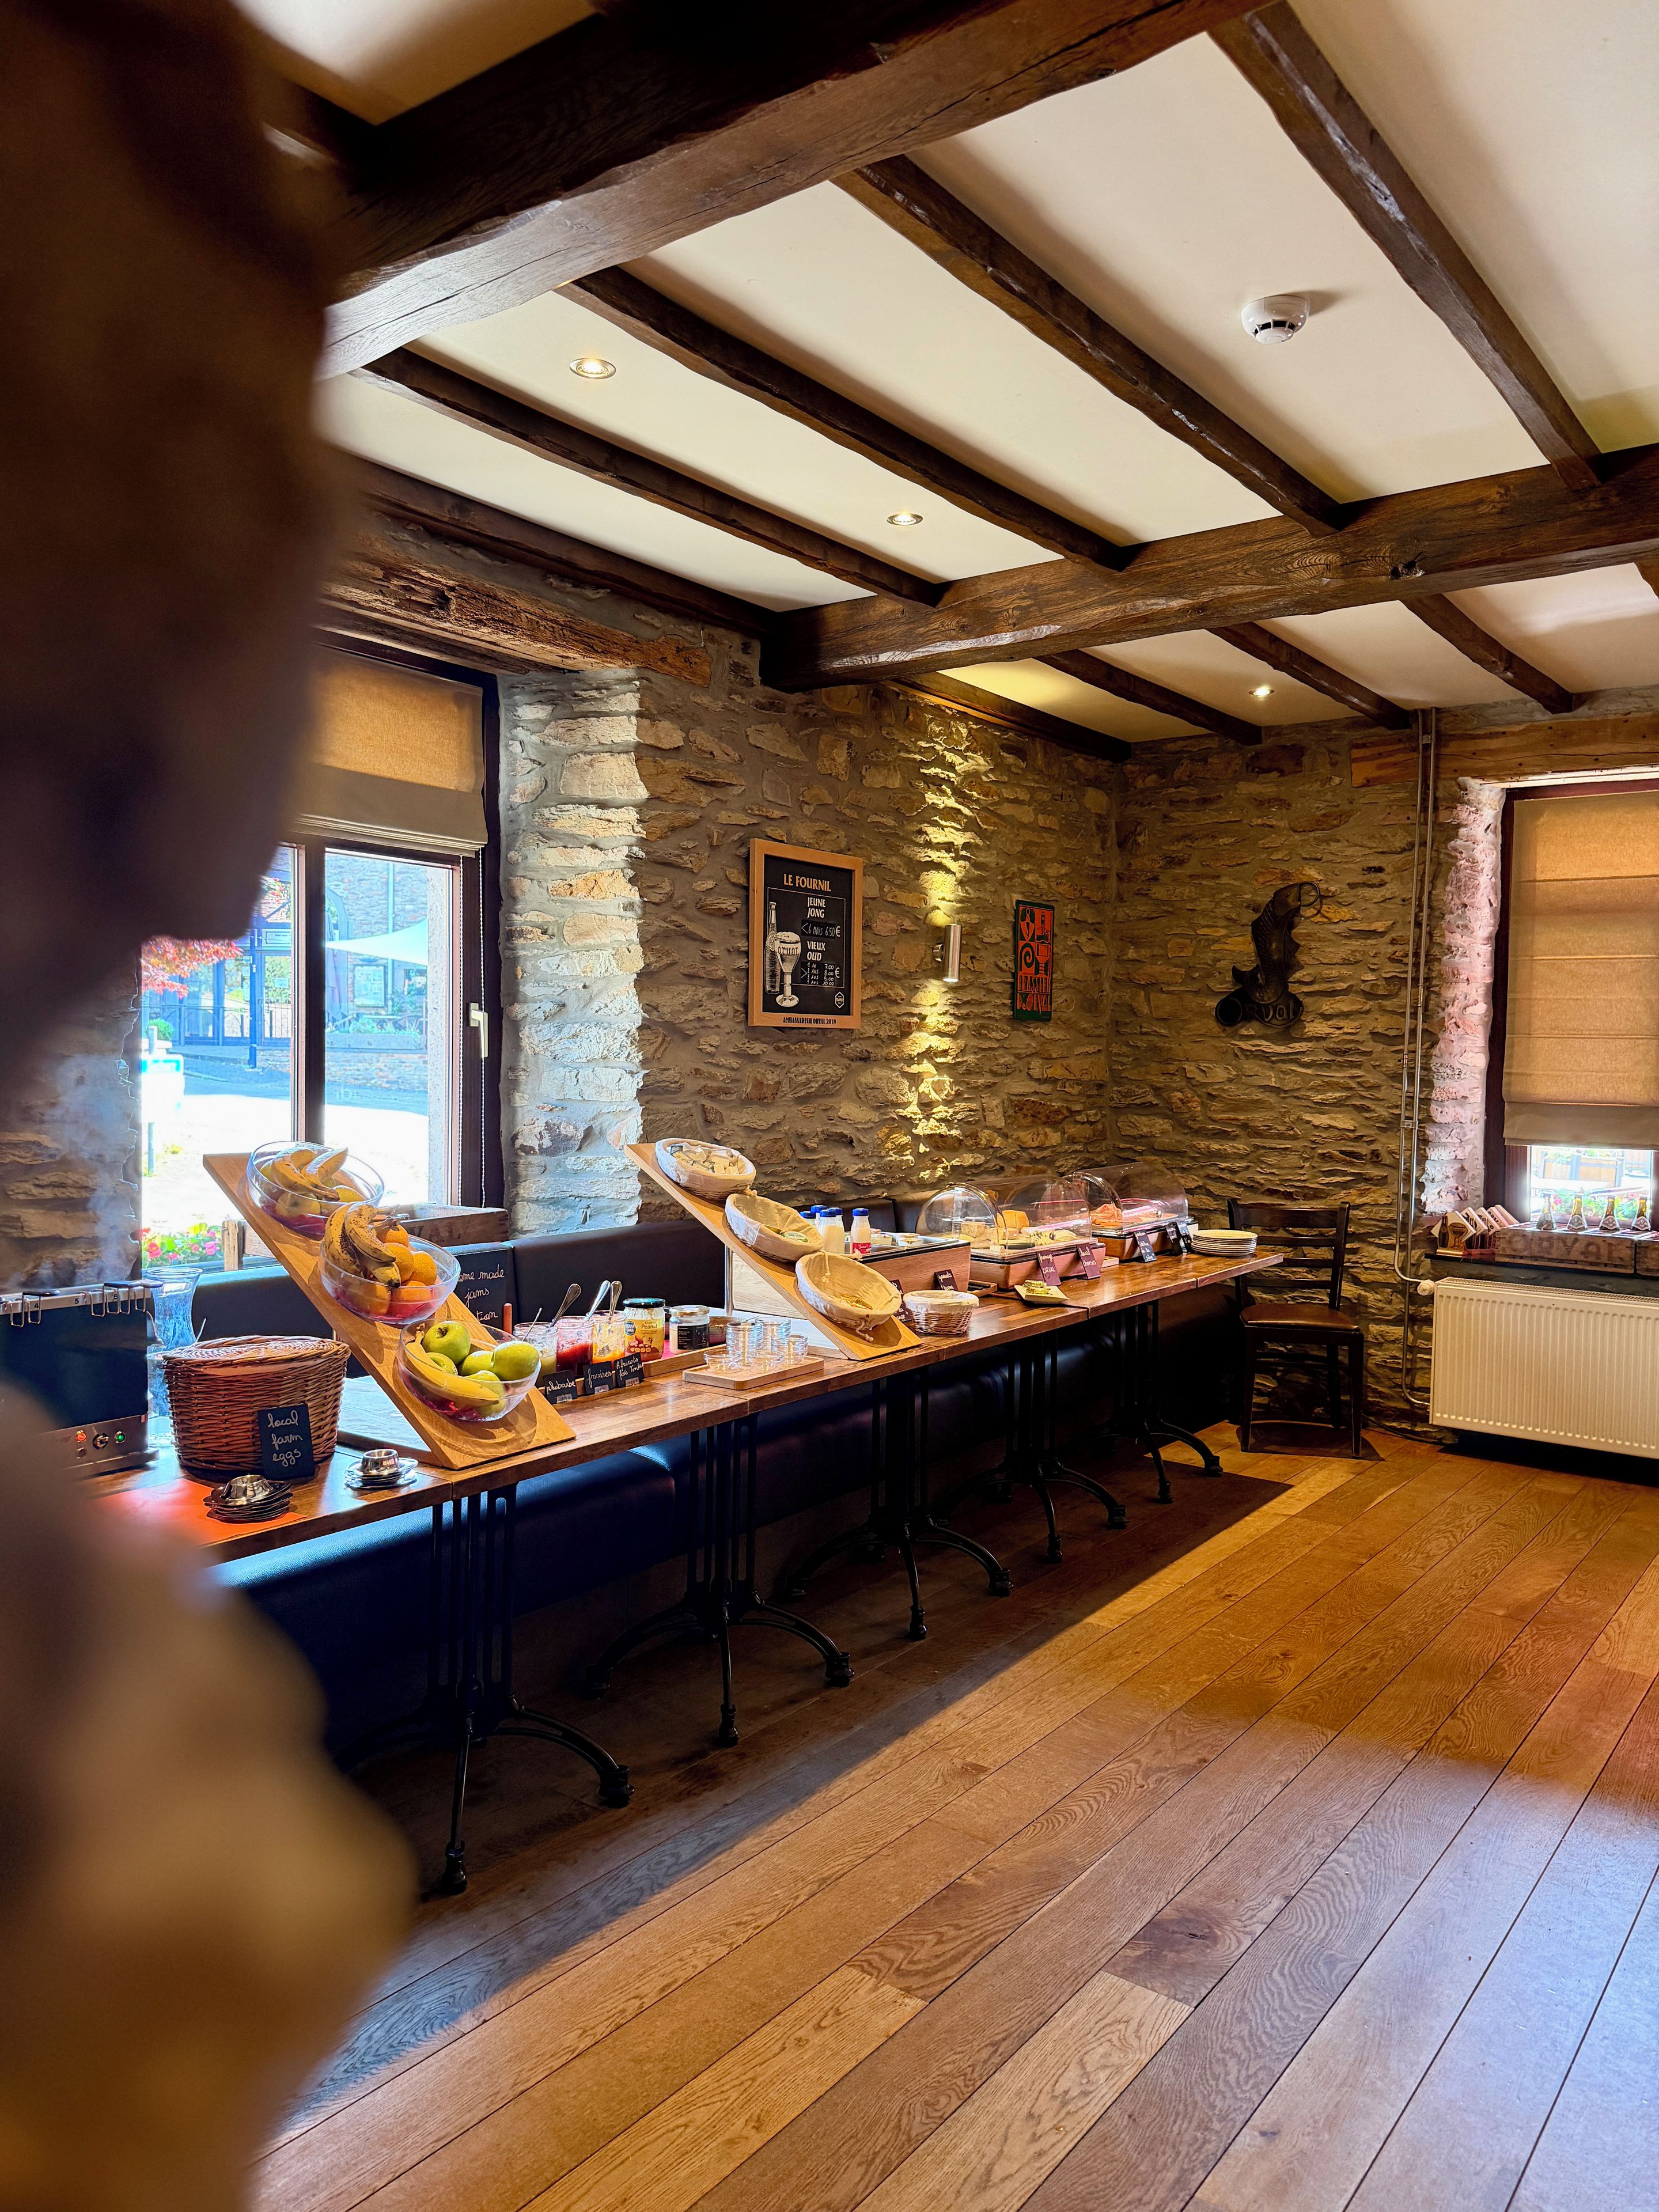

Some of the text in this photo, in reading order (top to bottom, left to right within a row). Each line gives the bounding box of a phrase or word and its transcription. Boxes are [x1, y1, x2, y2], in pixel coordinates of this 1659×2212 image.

[783, 873, 831, 892] LE FOURNIL
[807, 897, 826, 907] JEUNE
[806, 907, 825, 919] JONG
[806, 940, 826, 951] VIEUX
[806, 951, 822, 961] OUD
[459, 1264, 505, 1282] ome made
[464, 1287, 490, 1309] jams
[476, 1310, 498, 1321] tion
[586, 1368, 612, 1388] fraises
[268, 1410, 298, 1427] local
[272, 1433, 303, 1450] farm
[272, 1449, 301, 1467] eggs
